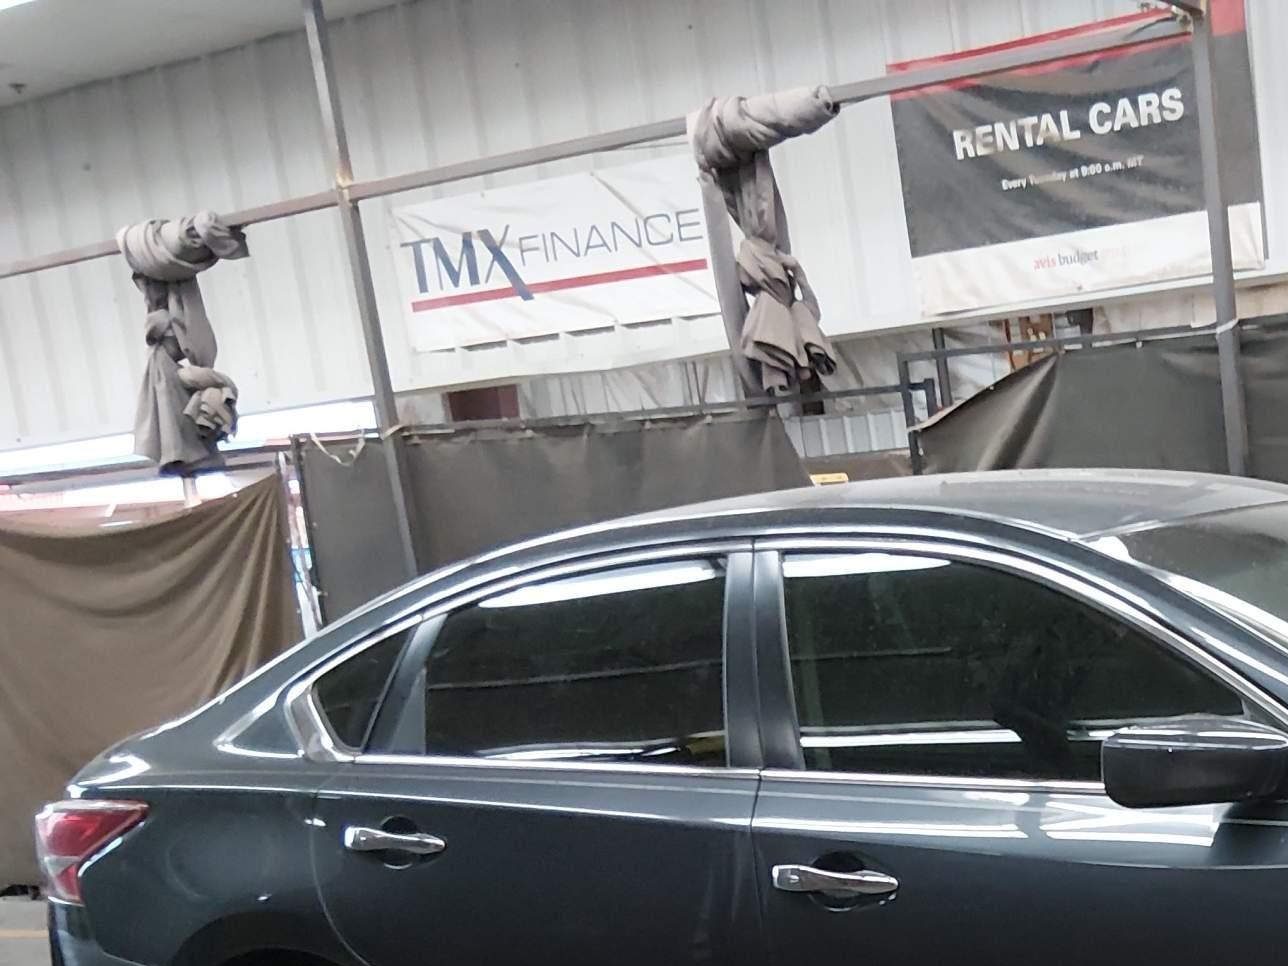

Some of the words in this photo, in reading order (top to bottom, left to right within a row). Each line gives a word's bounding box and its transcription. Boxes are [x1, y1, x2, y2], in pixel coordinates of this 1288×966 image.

[952, 110, 1081, 160] RENTAL
[1088, 87, 1185, 136] CARS
[1001, 177, 1027, 191] Every
[400, 225, 534, 301] TMX
[518, 208, 704, 267] FINANCE
[1057, 249, 1099, 267] budget
